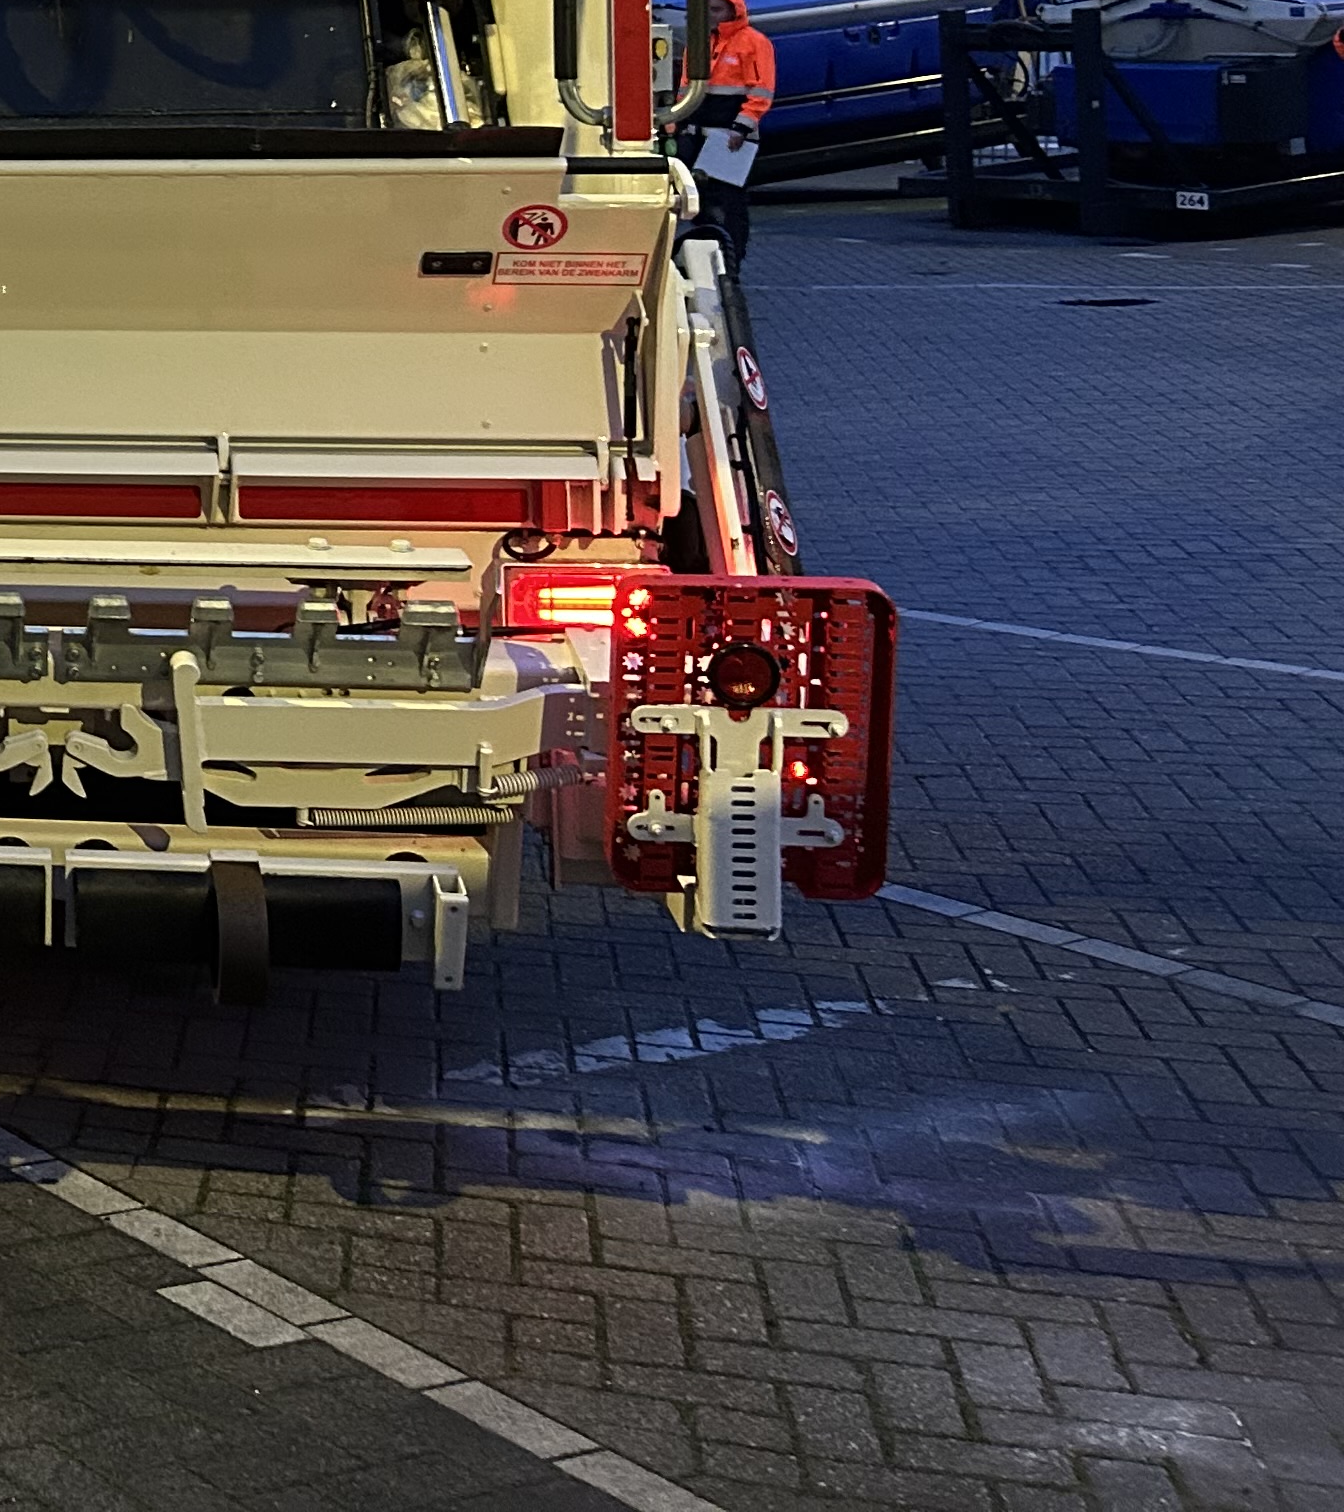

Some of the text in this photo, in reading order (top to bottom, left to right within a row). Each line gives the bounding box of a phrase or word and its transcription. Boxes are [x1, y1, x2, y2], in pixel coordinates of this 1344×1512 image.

[1179, 194, 1205, 207] 264
[565, 260, 603, 268] BINNEN
[606, 260, 627, 268] HET
[577, 269, 639, 277] ZWENKARM
